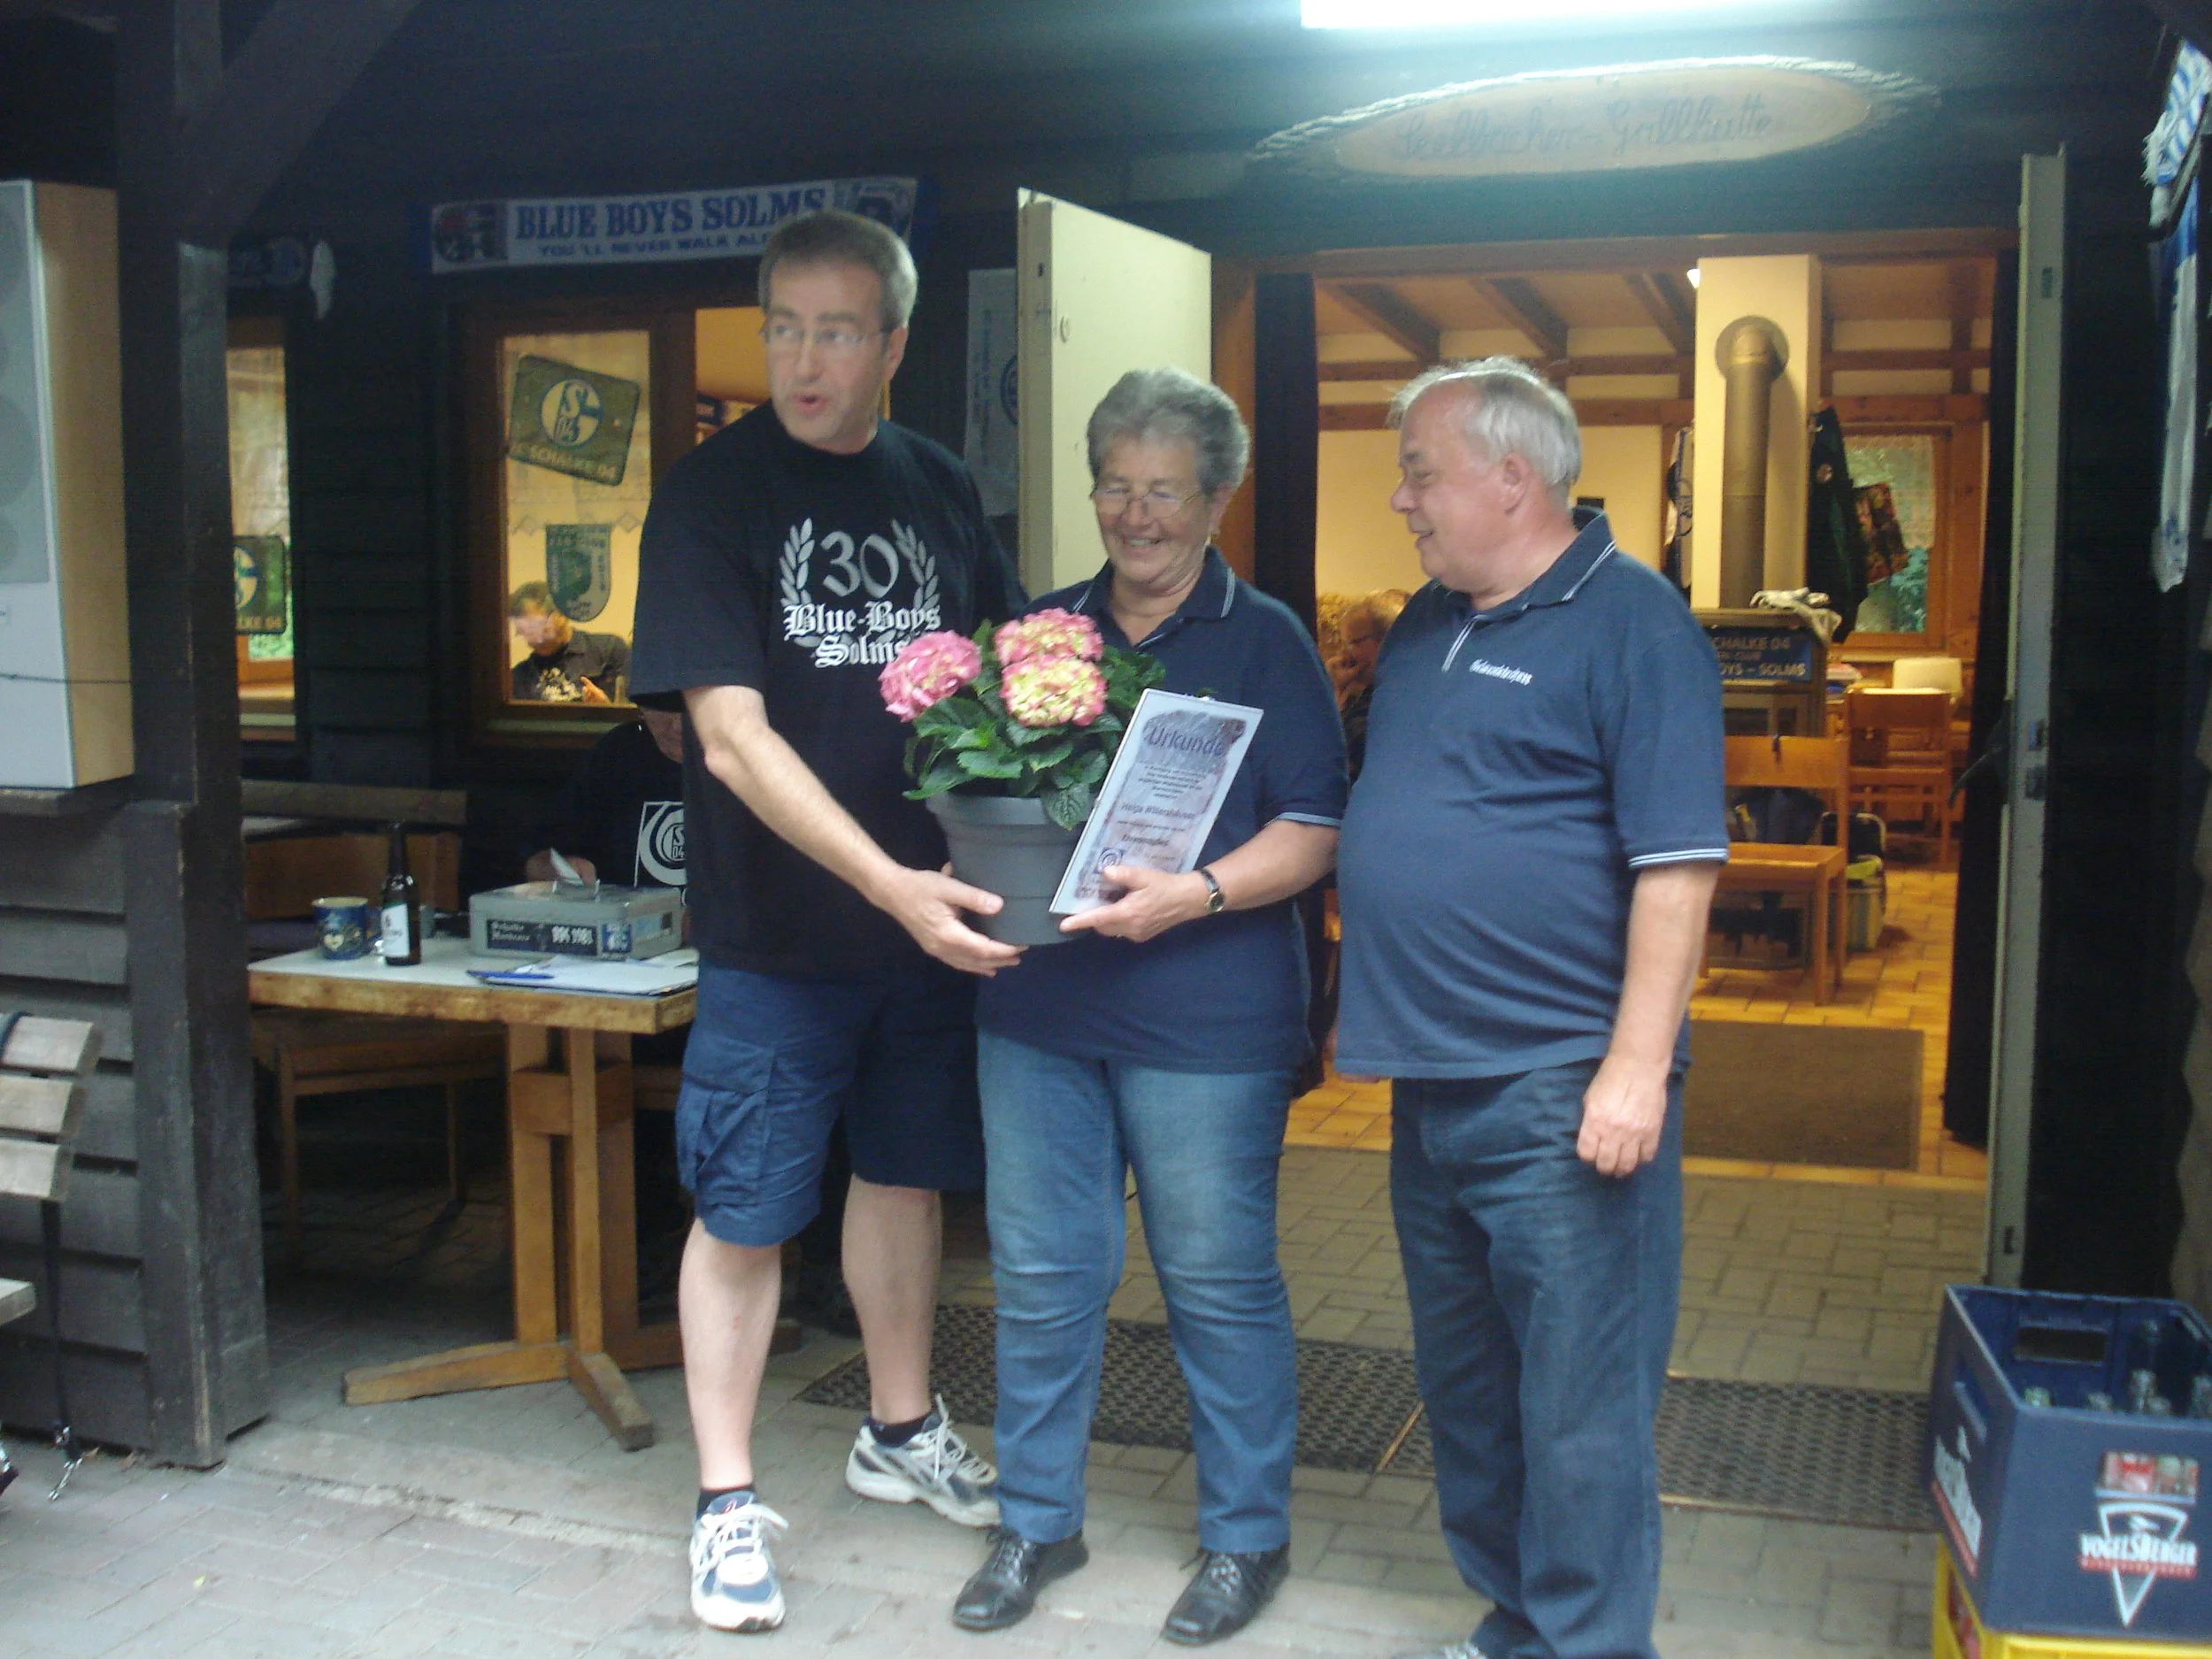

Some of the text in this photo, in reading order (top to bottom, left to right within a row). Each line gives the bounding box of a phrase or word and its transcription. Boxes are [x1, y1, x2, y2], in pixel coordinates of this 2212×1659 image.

[515, 187, 826, 240] BLUE BOYS SOLMS
[819, 530, 899, 598] 30
[1148, 725, 1224, 757] Urkunde
